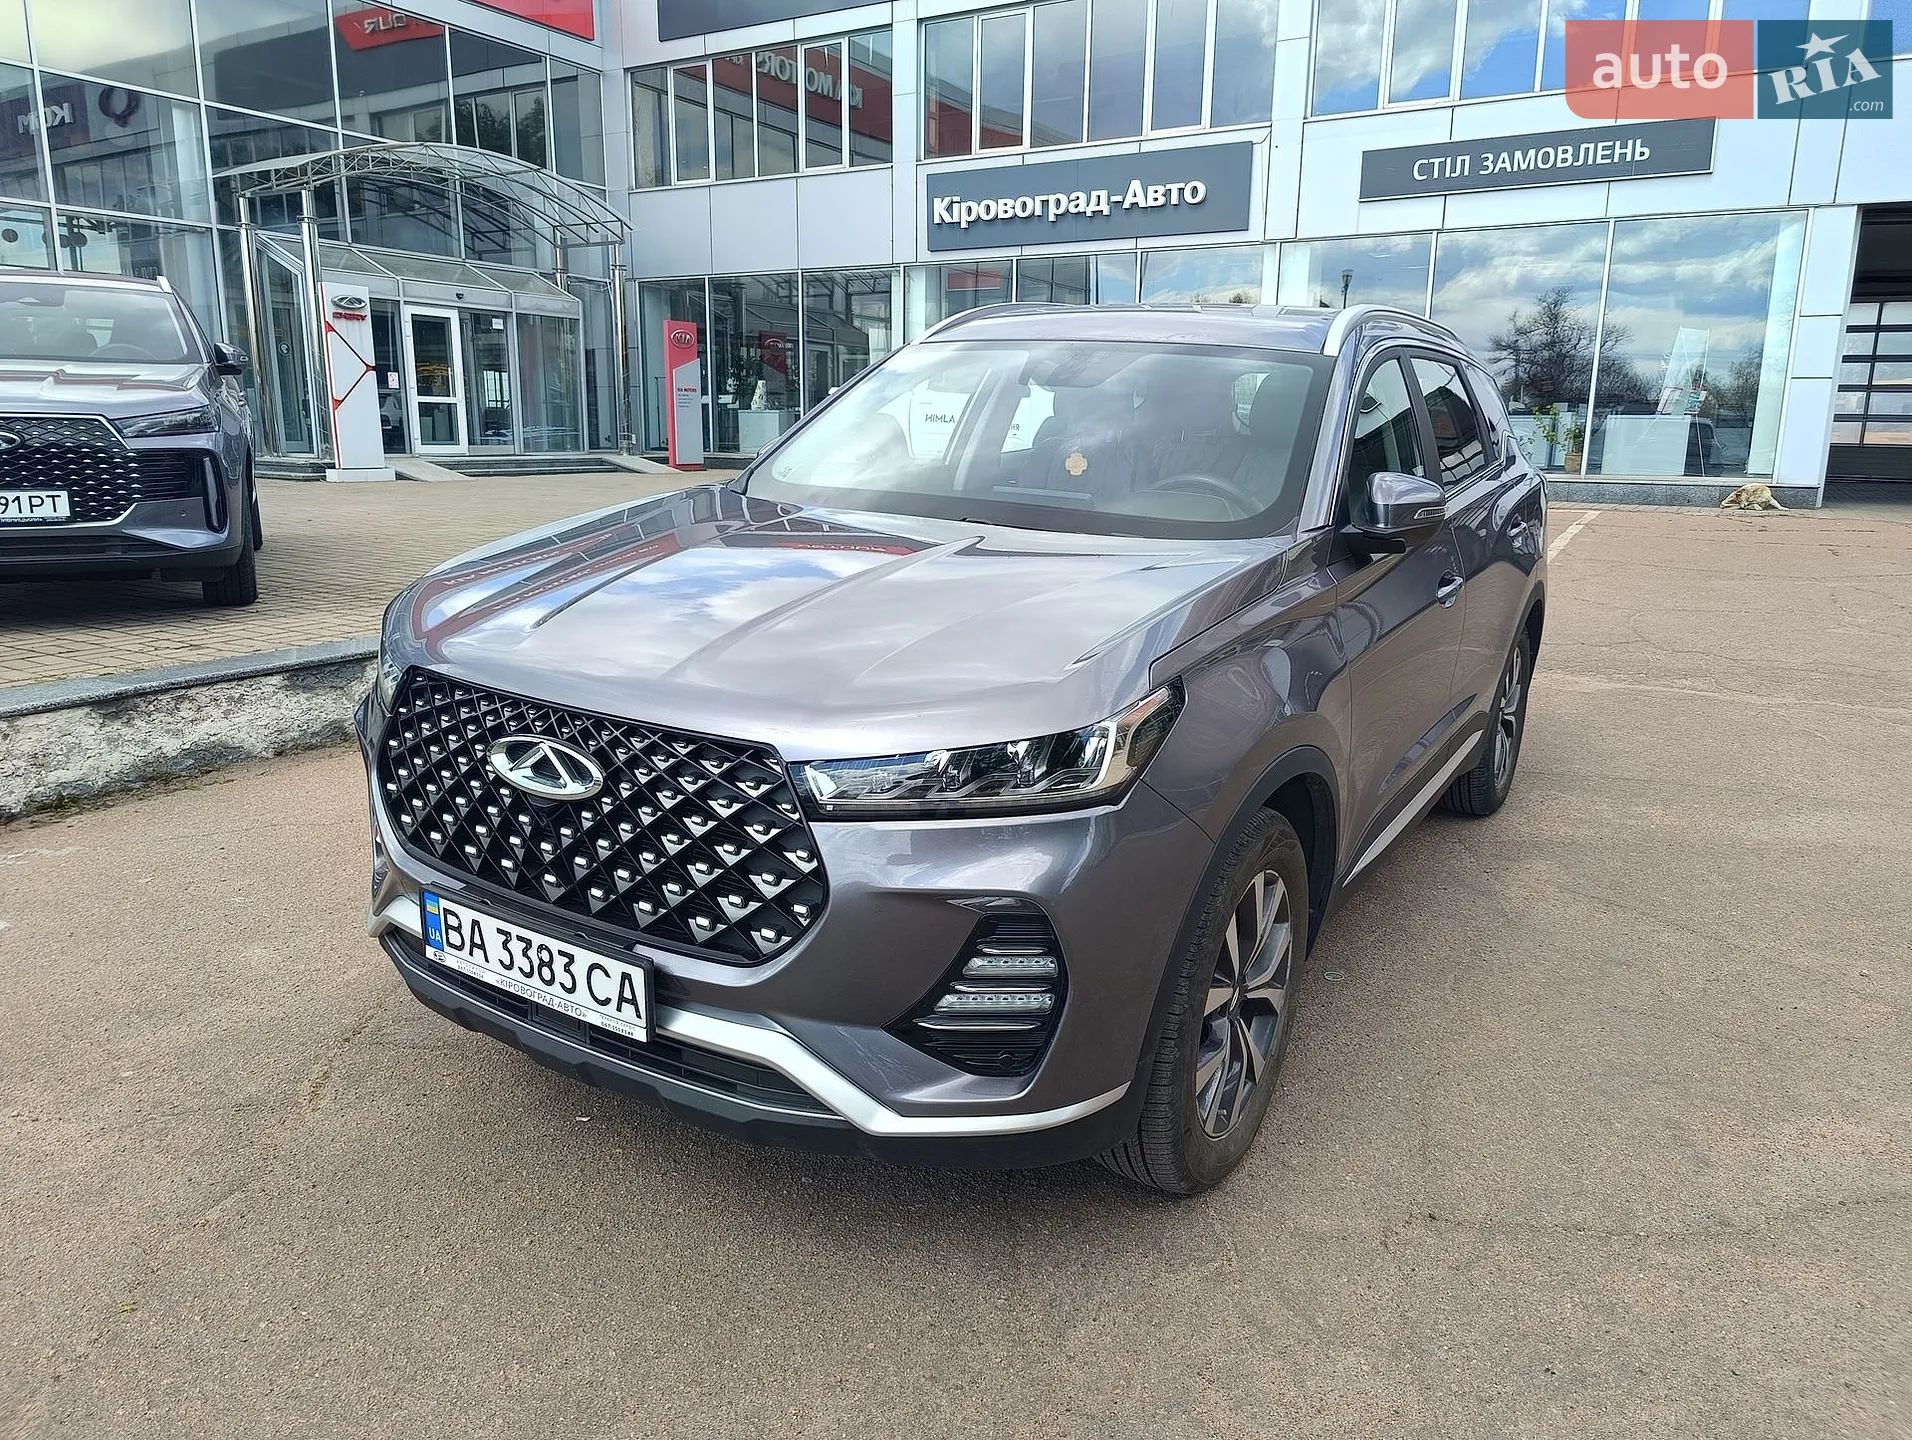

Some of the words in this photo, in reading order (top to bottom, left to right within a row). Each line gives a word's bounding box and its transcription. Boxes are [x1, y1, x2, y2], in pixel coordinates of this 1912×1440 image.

[1413, 154, 1470, 181] СТІЛ
[1478, 138, 1651, 175] ЗАМОВЛЕНЬ
[933, 179, 1207, 228] Кіровоград-Авто
[925, 414, 955, 423] HIMLA
[28, 495, 61, 513] PT
[428, 926, 442, 944] UA
[443, 907, 490, 964] BA
[496, 927, 578, 995] 3383
[586, 962, 643, 1020] CA
